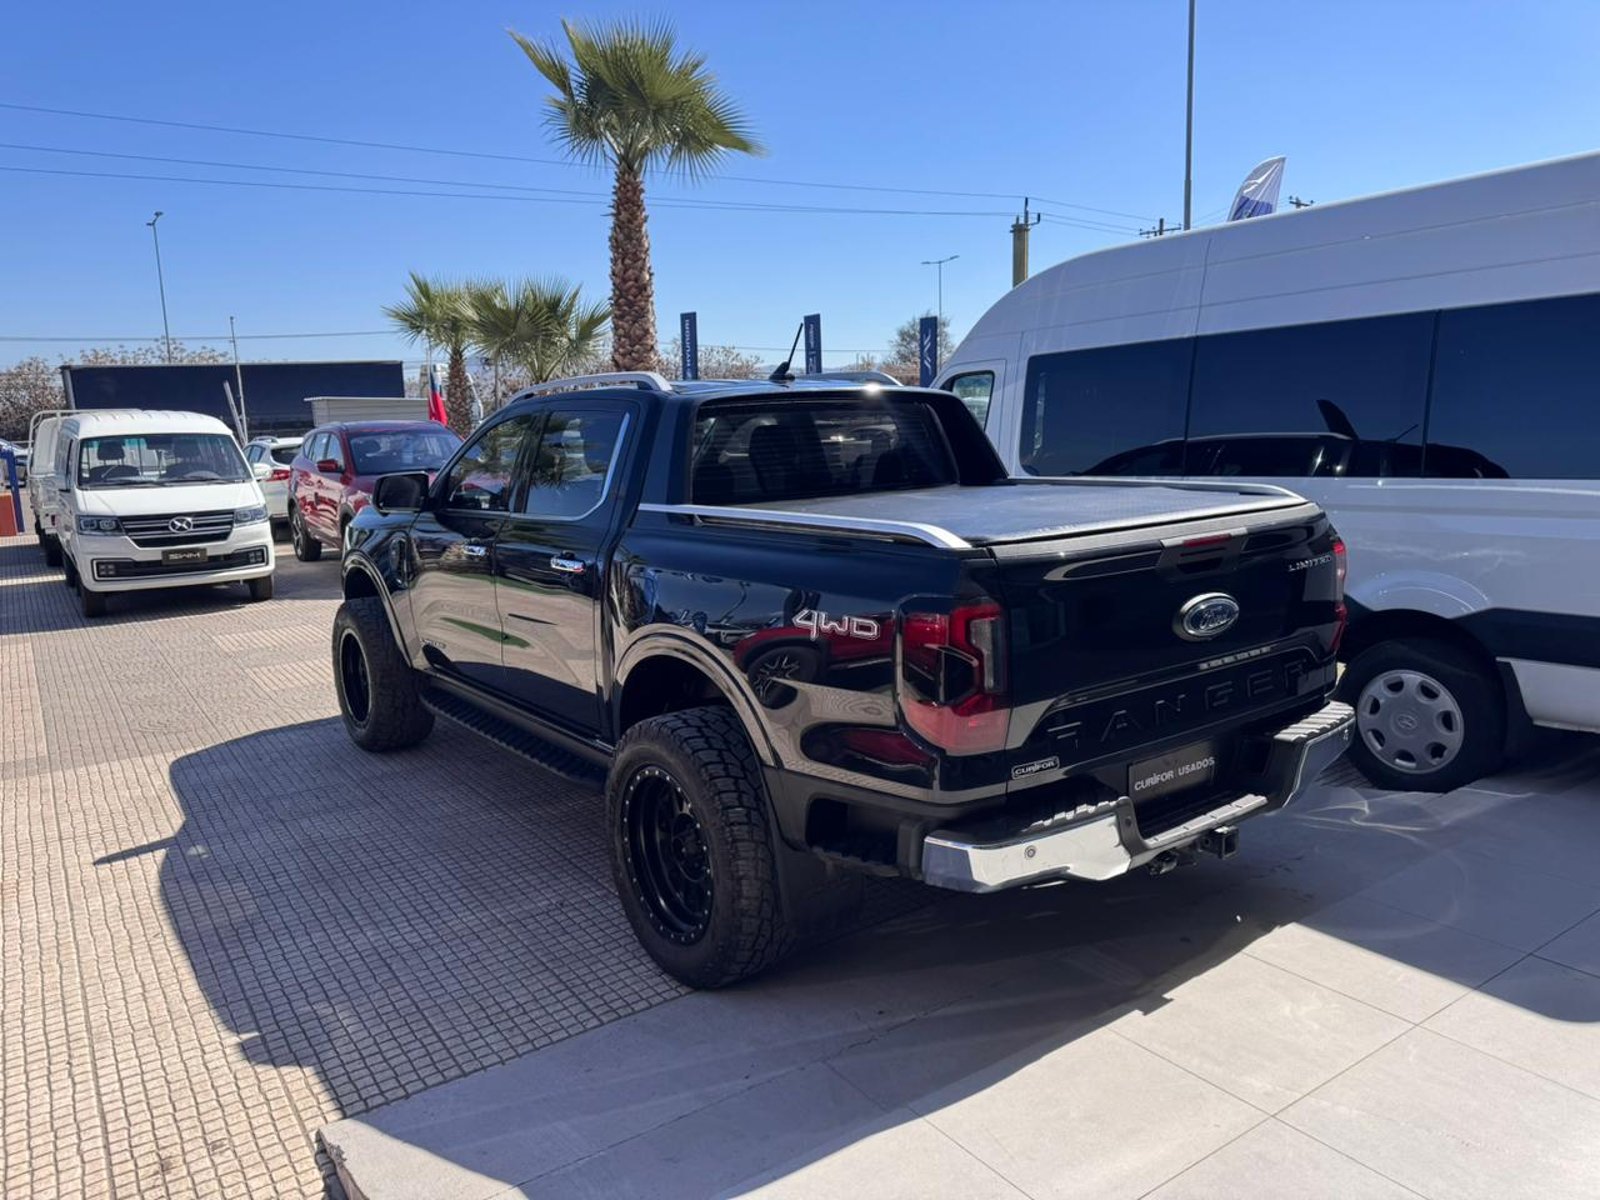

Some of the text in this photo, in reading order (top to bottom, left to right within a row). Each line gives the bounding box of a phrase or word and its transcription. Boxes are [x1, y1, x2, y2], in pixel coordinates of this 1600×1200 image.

[1288, 555, 1331, 571] LIMITED
[792, 608, 880, 641] 4WD
[1046, 658, 1310, 751] RANGER
[1178, 756, 1215, 776] USADOS
